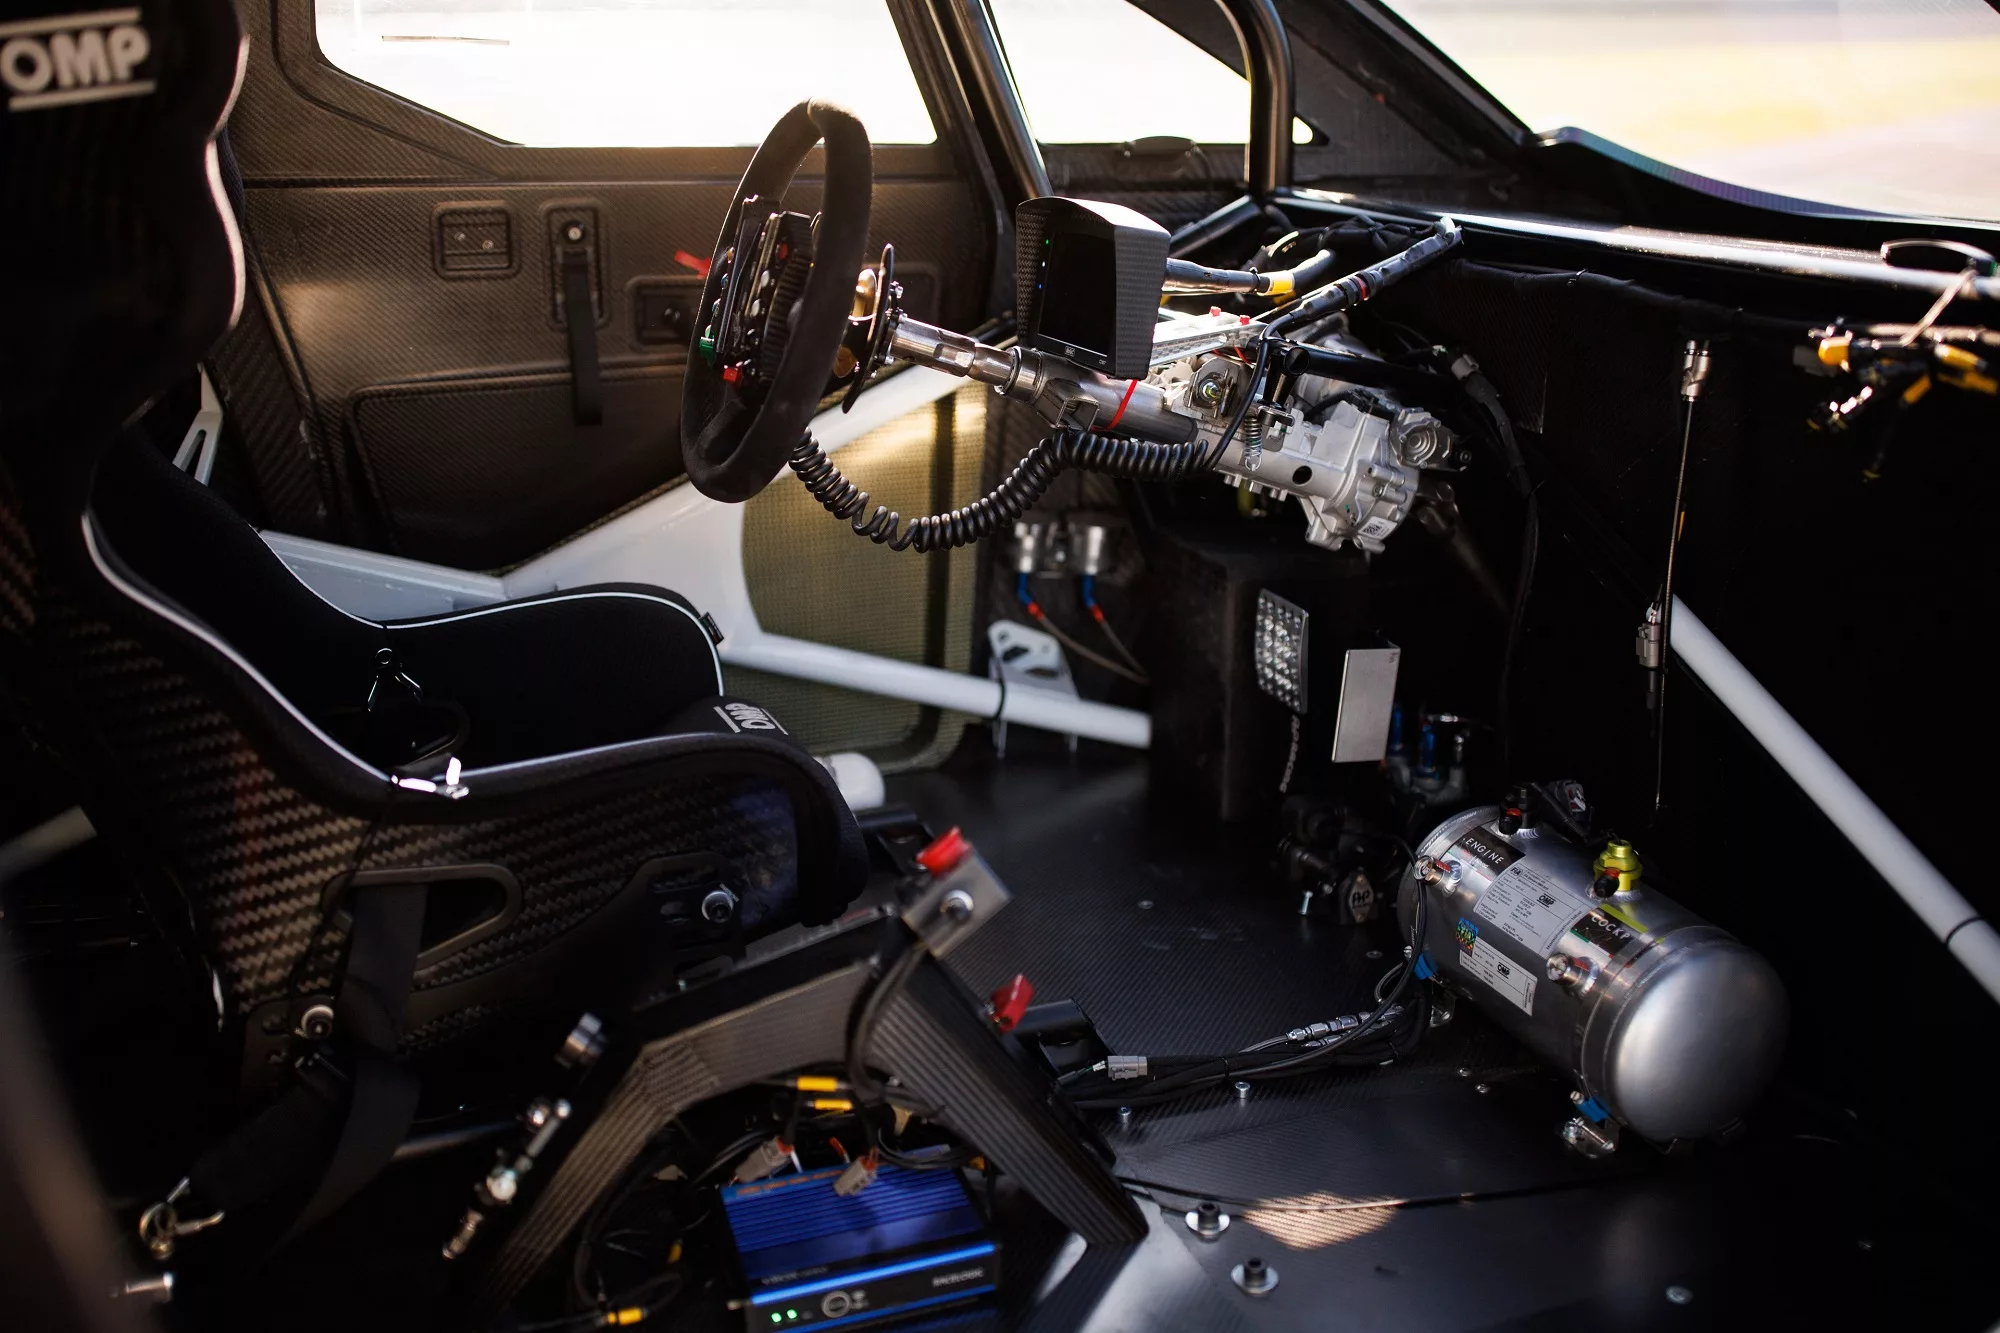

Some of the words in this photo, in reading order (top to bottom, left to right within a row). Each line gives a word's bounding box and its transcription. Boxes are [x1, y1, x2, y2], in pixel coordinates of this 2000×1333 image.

[0, 25, 150, 92] OMP
[725, 703, 776, 730] OMP
[1465, 837, 1505, 865] ENGINE
[1538, 893, 1556, 907] OMP
[1497, 963, 1510, 977] OMP
